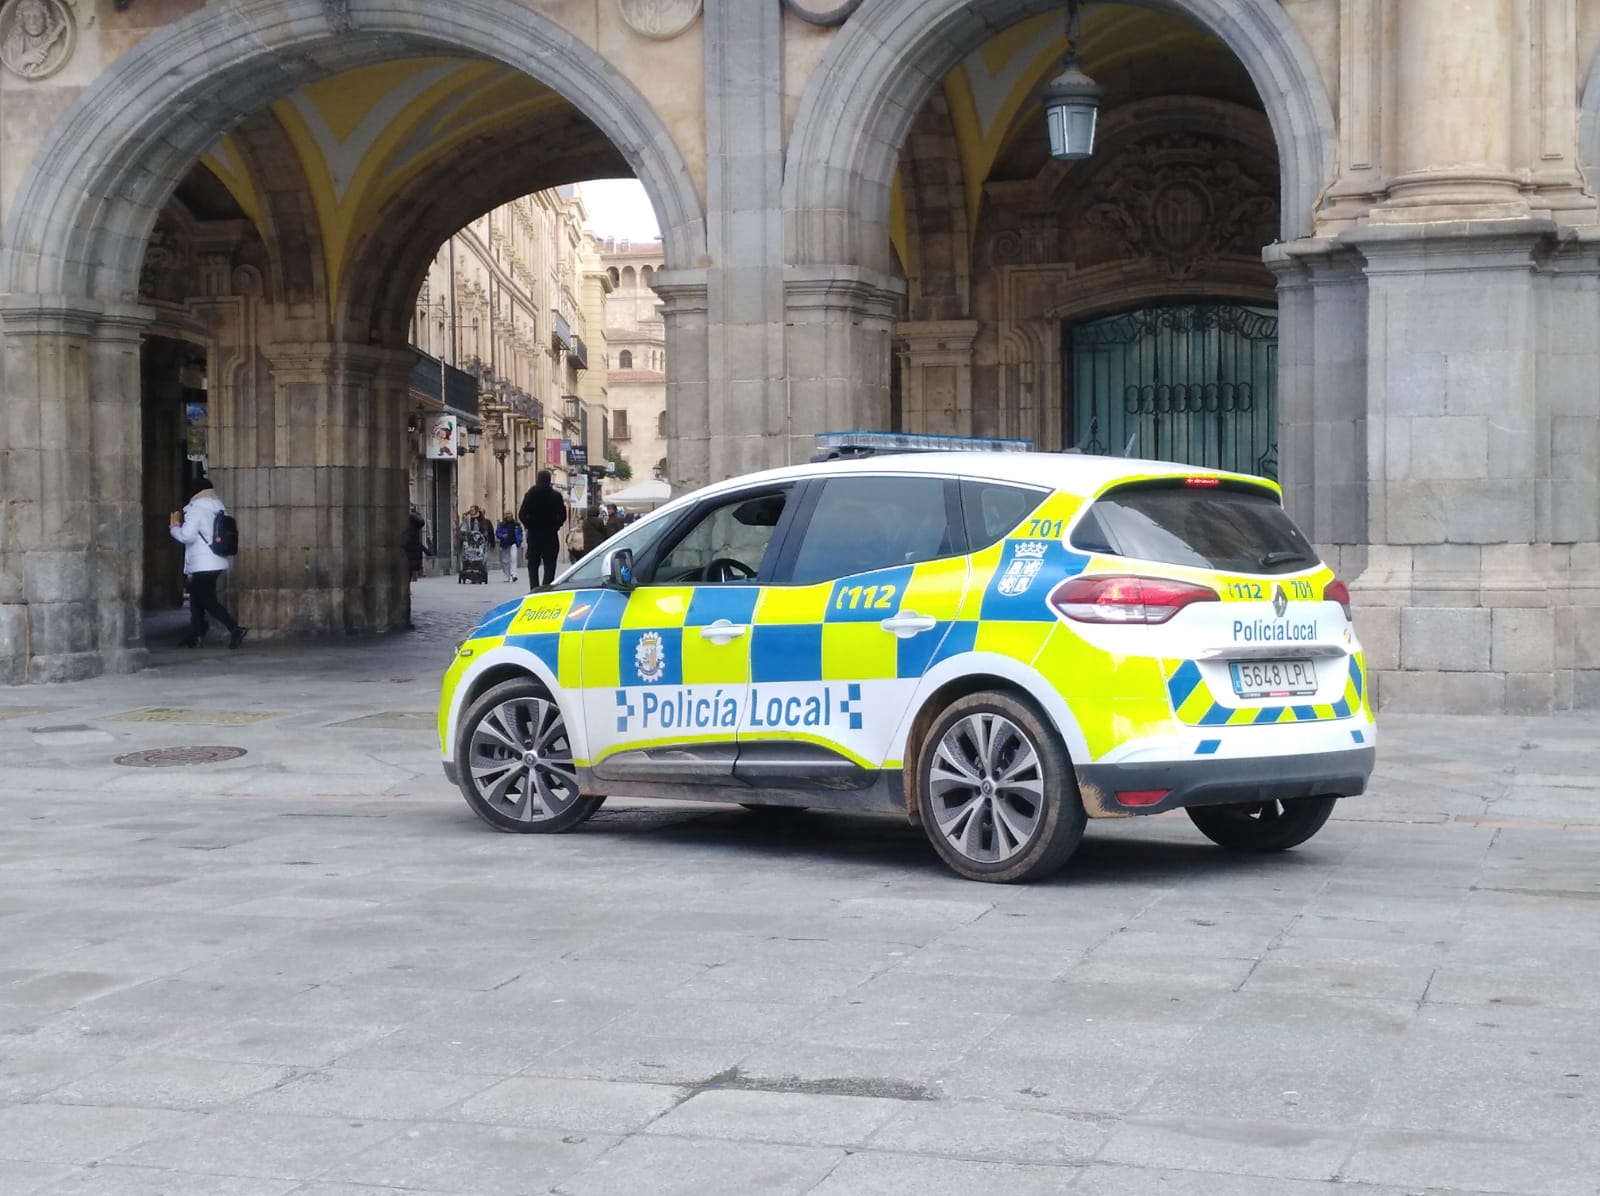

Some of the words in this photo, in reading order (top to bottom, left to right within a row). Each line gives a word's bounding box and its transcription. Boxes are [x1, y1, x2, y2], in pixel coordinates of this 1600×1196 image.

[1029, 519, 1063, 538] 701
[848, 584, 897, 609] 112
[1234, 582, 1263, 599] 112
[1290, 580, 1314, 599] 701
[1233, 618, 1285, 641] Policía
[1286, 619, 1318, 641] Local
[1241, 664, 1282, 687] 5648
[1284, 663, 1313, 686] LPL
[642, 689, 738, 729] Policía
[750, 687, 831, 727] Local
